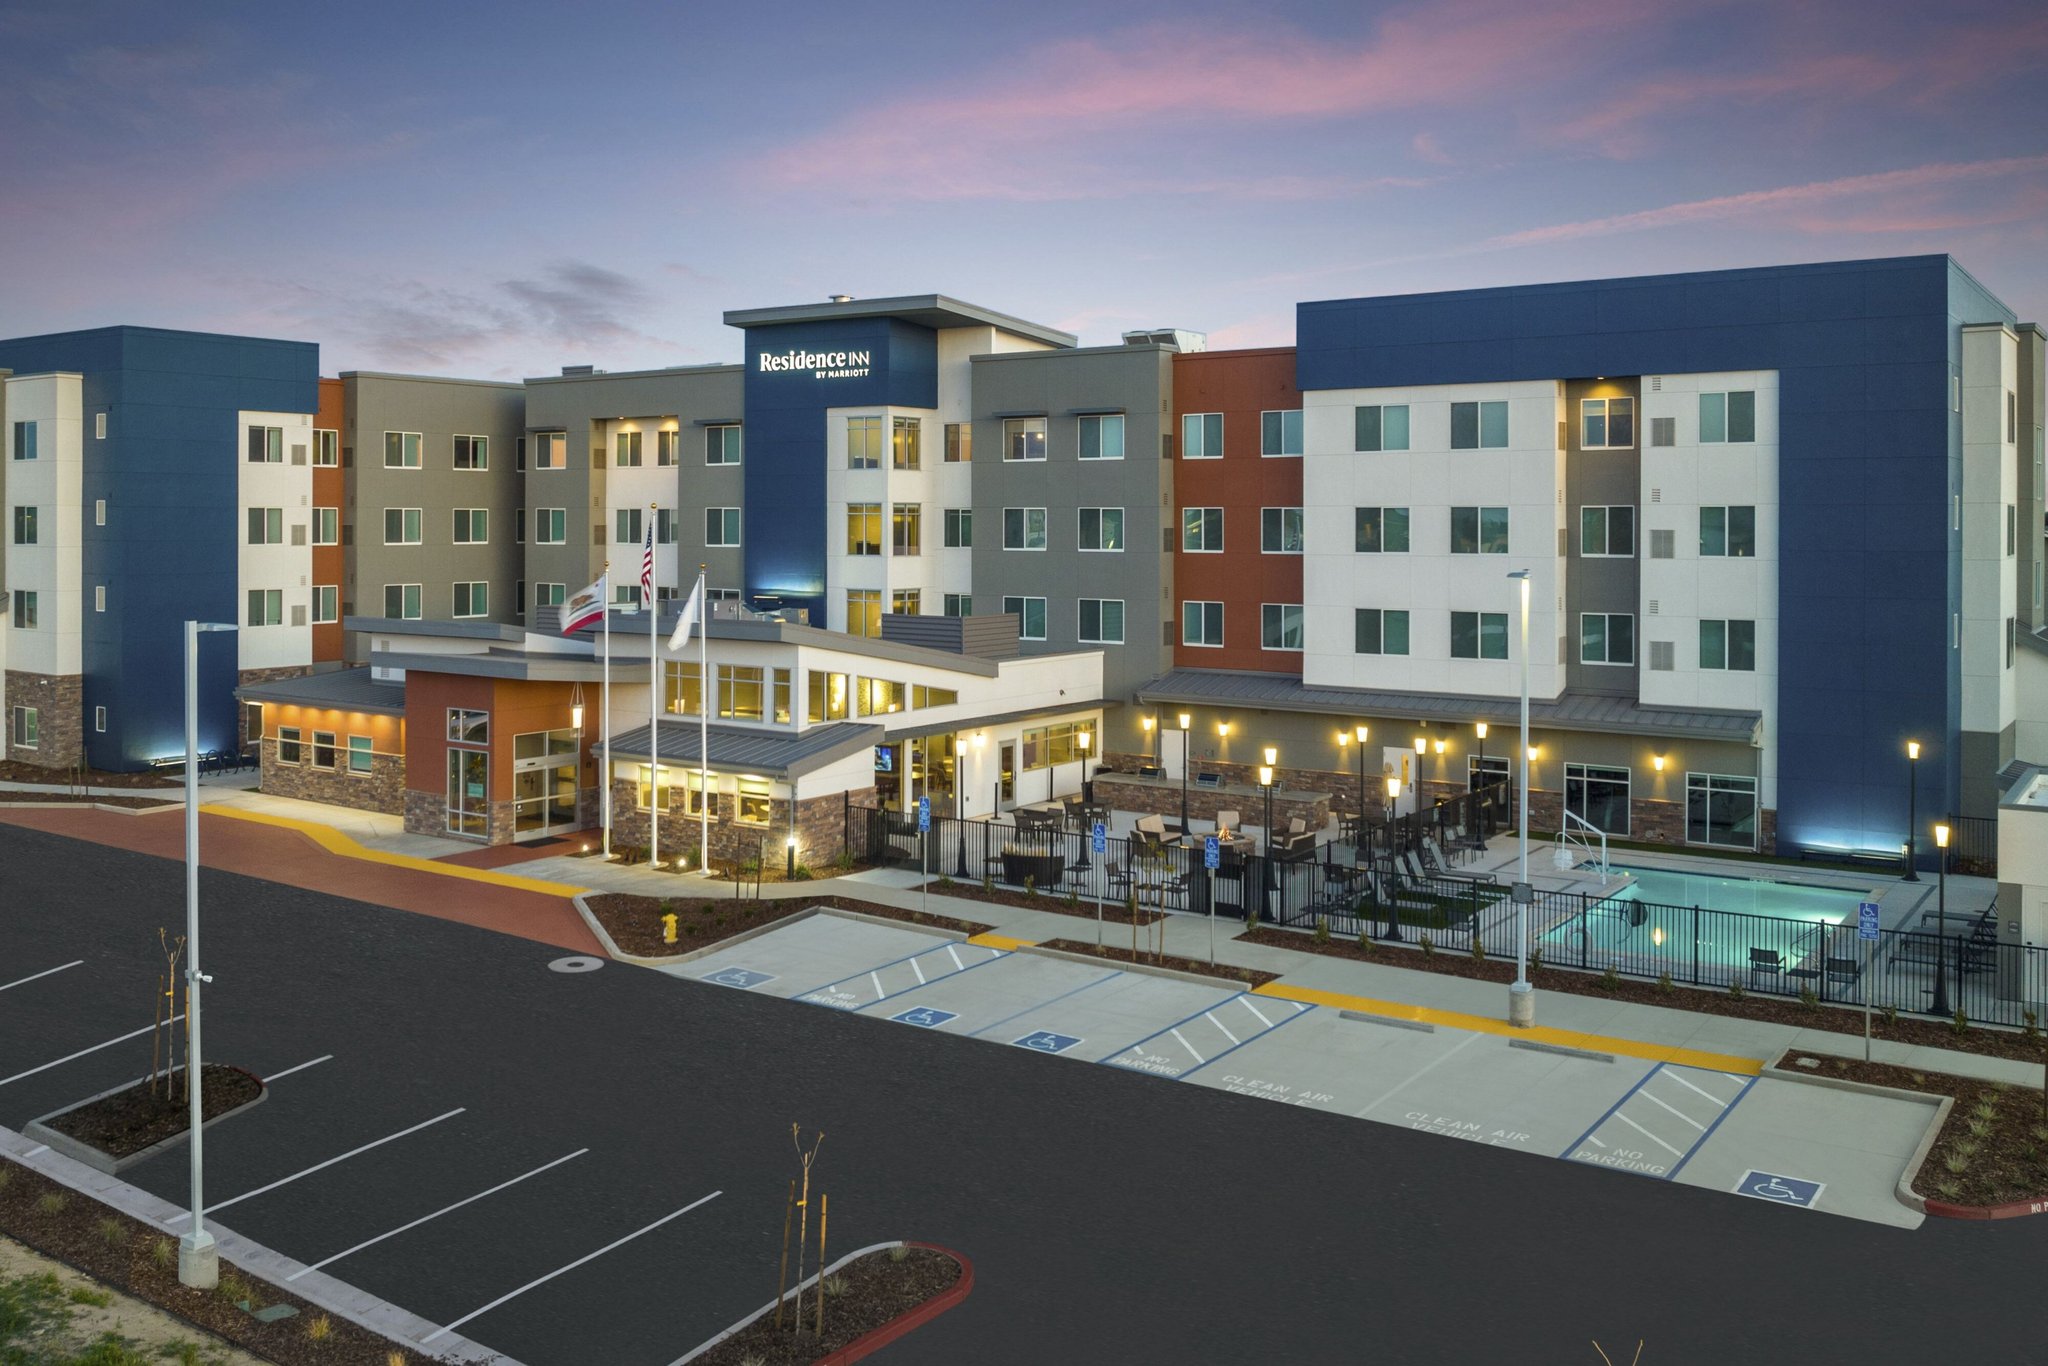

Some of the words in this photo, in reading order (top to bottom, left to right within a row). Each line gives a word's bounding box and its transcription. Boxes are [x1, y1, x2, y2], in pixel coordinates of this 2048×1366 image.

[760, 350, 846, 372] Residence
[849, 351, 869, 367] INN
[816, 371, 826, 379] BY
[828, 368, 869, 379] MARRIOTT
[1111, 1057, 1180, 1075] PARKING
[1222, 1075, 1291, 1093] CLEAN
[1298, 1091, 1334, 1102] AIR
[1405, 1112, 1481, 1131] CLEAN
[1490, 1129, 1530, 1142] AIR
[1575, 1151, 1665, 1174] PARKING
[1612, 1148, 1643, 1160] NO
[2031, 1202, 2041, 1214] NO
